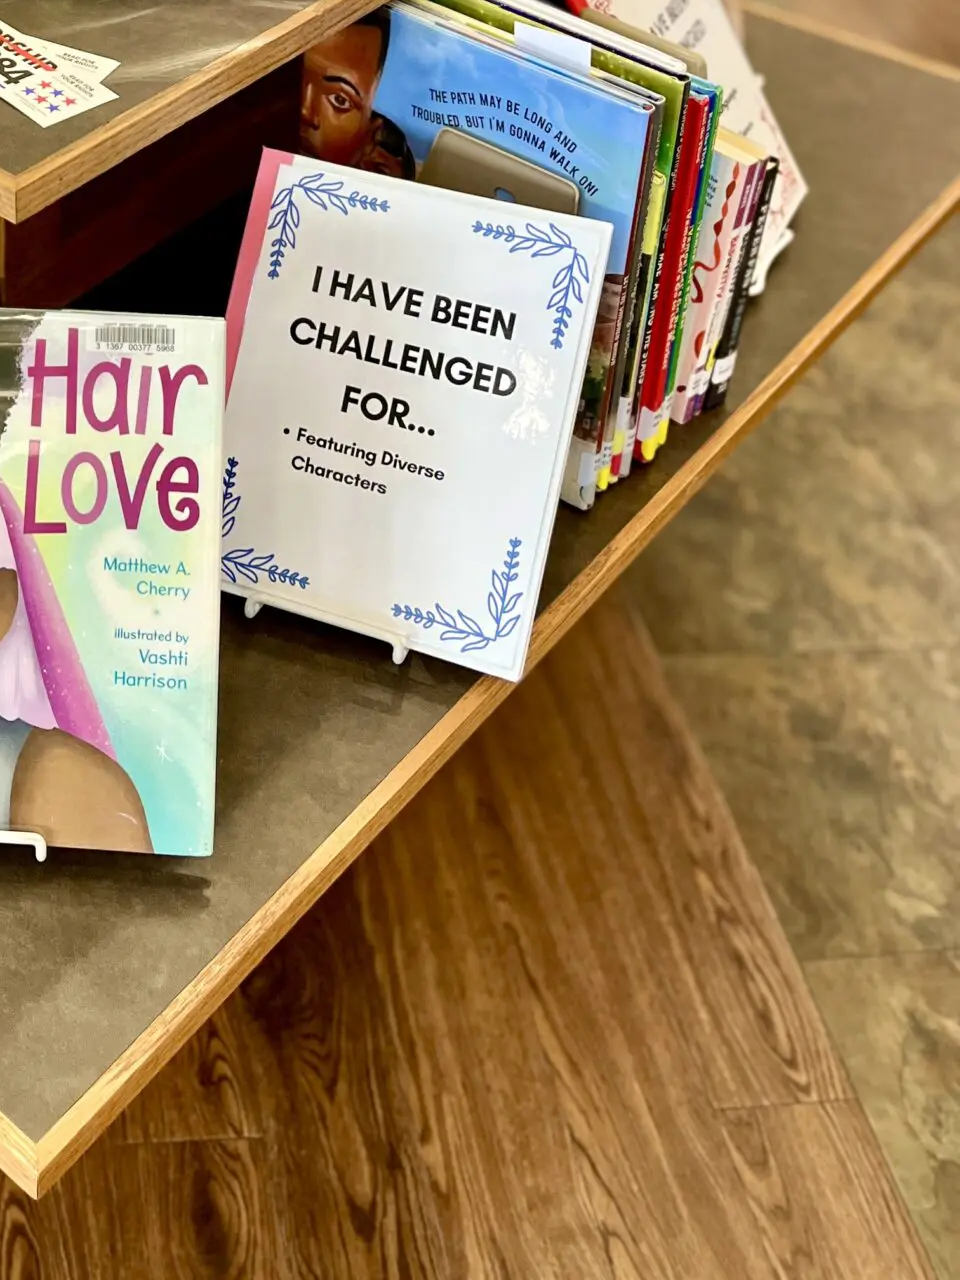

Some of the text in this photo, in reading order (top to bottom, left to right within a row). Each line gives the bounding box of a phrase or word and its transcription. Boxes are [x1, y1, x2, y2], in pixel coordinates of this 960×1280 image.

[429, 88, 578, 154] THE PATH MAY BE LONG AND
[466, 115, 485, 130] BUT
[489, 116, 505, 133] I'M
[509, 123, 545, 153] GONNA
[549, 148, 579, 179] WALK
[312, 265, 517, 341] I HAVE BEEN
[128, 344, 151, 352] 00377
[290, 317, 517, 397] CHALLENGED
[28, 328, 209, 436] Hair
[340, 385, 435, 437] FOR...
[291, 455, 387, 495] Characters
[296, 427, 445, 481] Featuring Diverse
[103, 557, 190, 576] Matthew A.
[136, 581, 190, 601] Cherry
[114, 628, 189, 645] illustrated by
[139, 649, 188, 666] Vashti
[114, 671, 187, 690] Harrison
